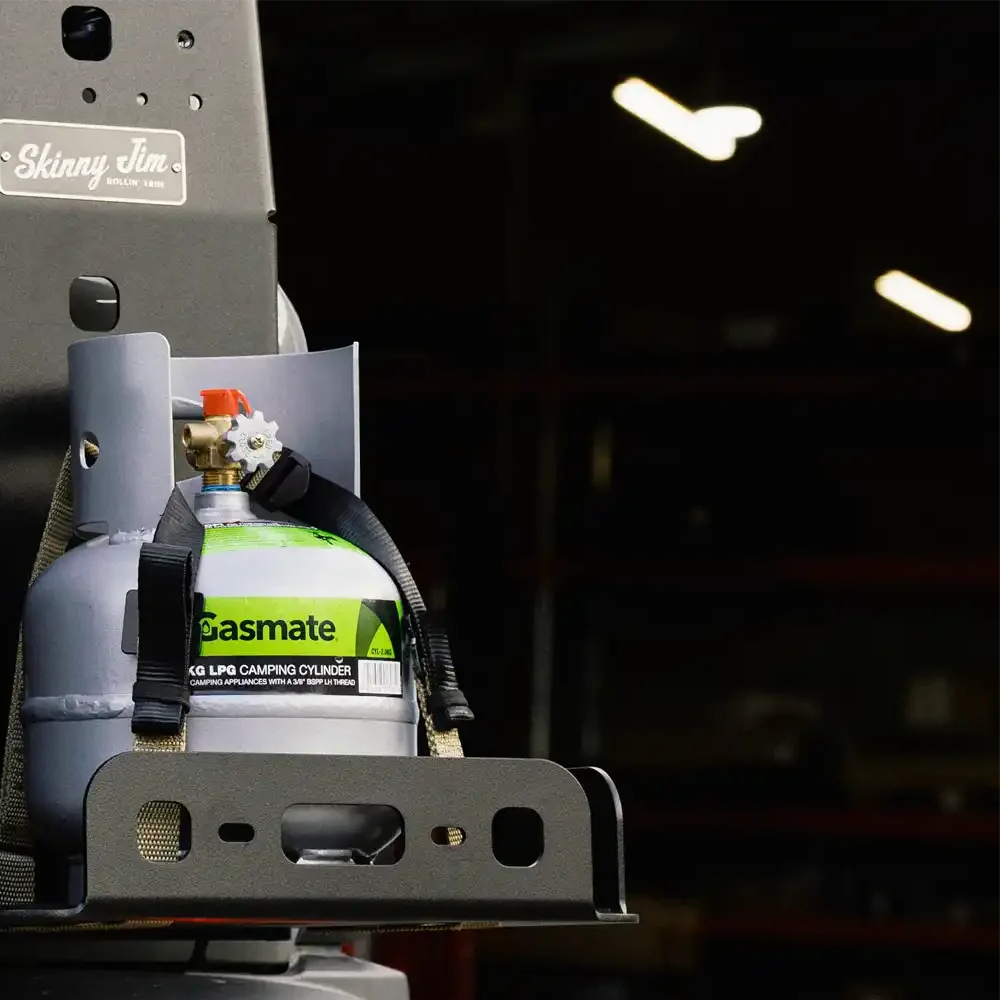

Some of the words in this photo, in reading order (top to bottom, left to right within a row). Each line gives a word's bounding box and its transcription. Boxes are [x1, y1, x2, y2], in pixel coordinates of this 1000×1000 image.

[14, 143, 109, 190] Skinny
[117, 138, 168, 173] Jim
[200, 611, 336, 642] Gasmate
[209, 665, 237, 676] LPG
[239, 664, 296, 676] CAMPING
[299, 664, 352, 676] CYLINDER
[224, 678, 268, 686] APPLIANCES
[307, 678, 324, 686] BSPP
